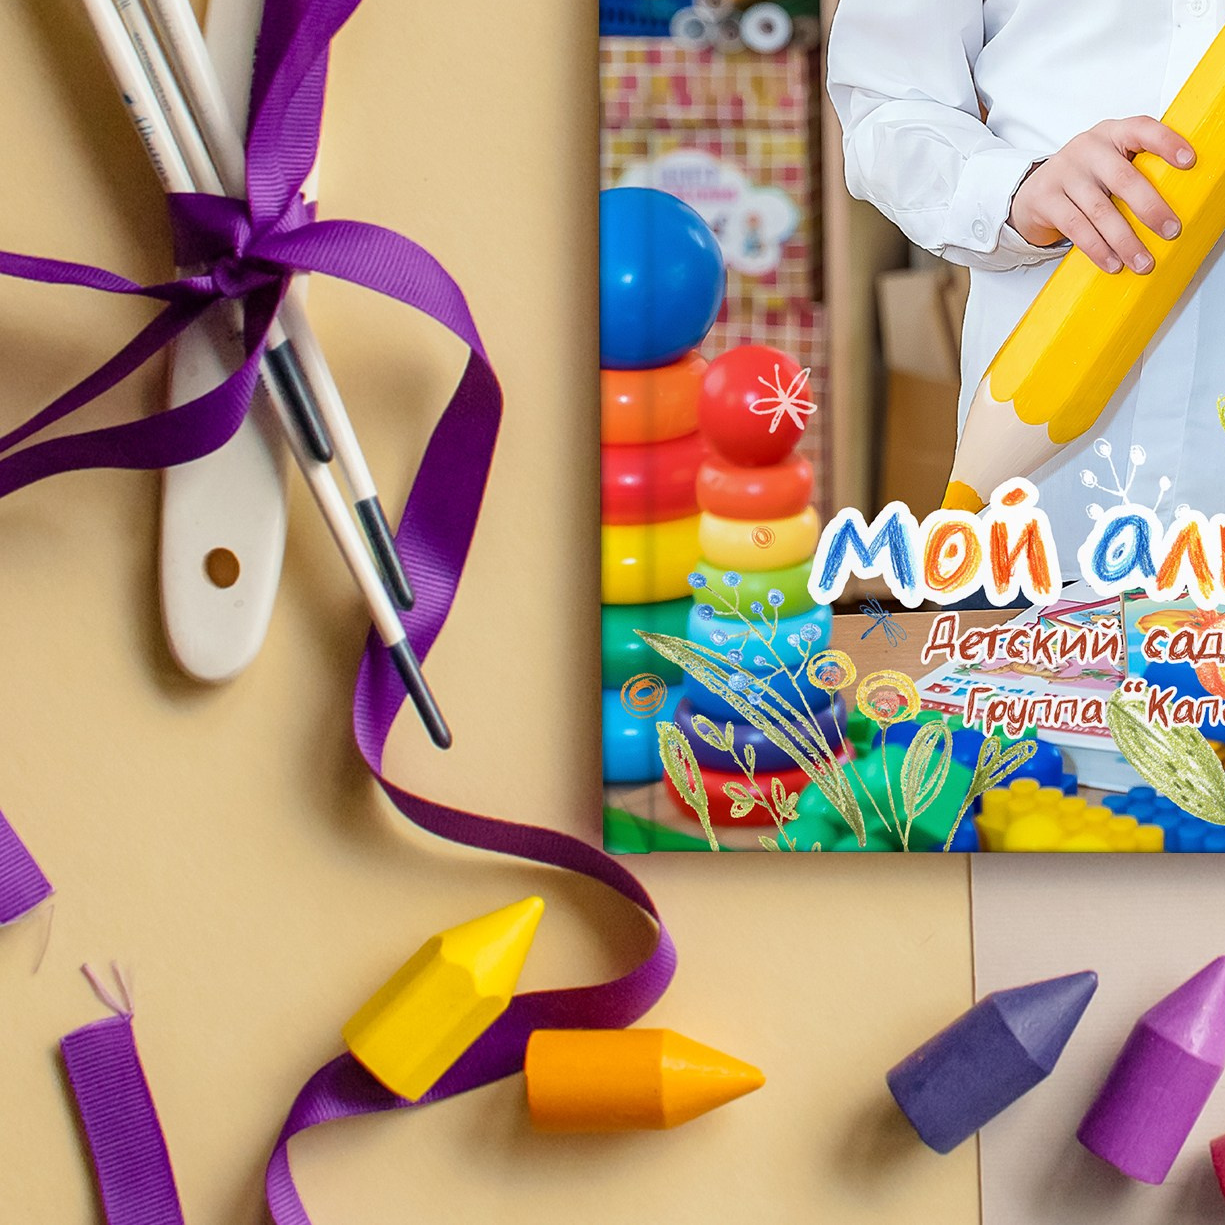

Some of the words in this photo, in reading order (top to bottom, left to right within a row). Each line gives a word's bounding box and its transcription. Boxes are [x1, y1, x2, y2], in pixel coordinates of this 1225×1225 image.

[923, 615, 1120, 663] Детский
[1143, 629, 1225, 664] сад
[965, 687, 1104, 736] Группа
